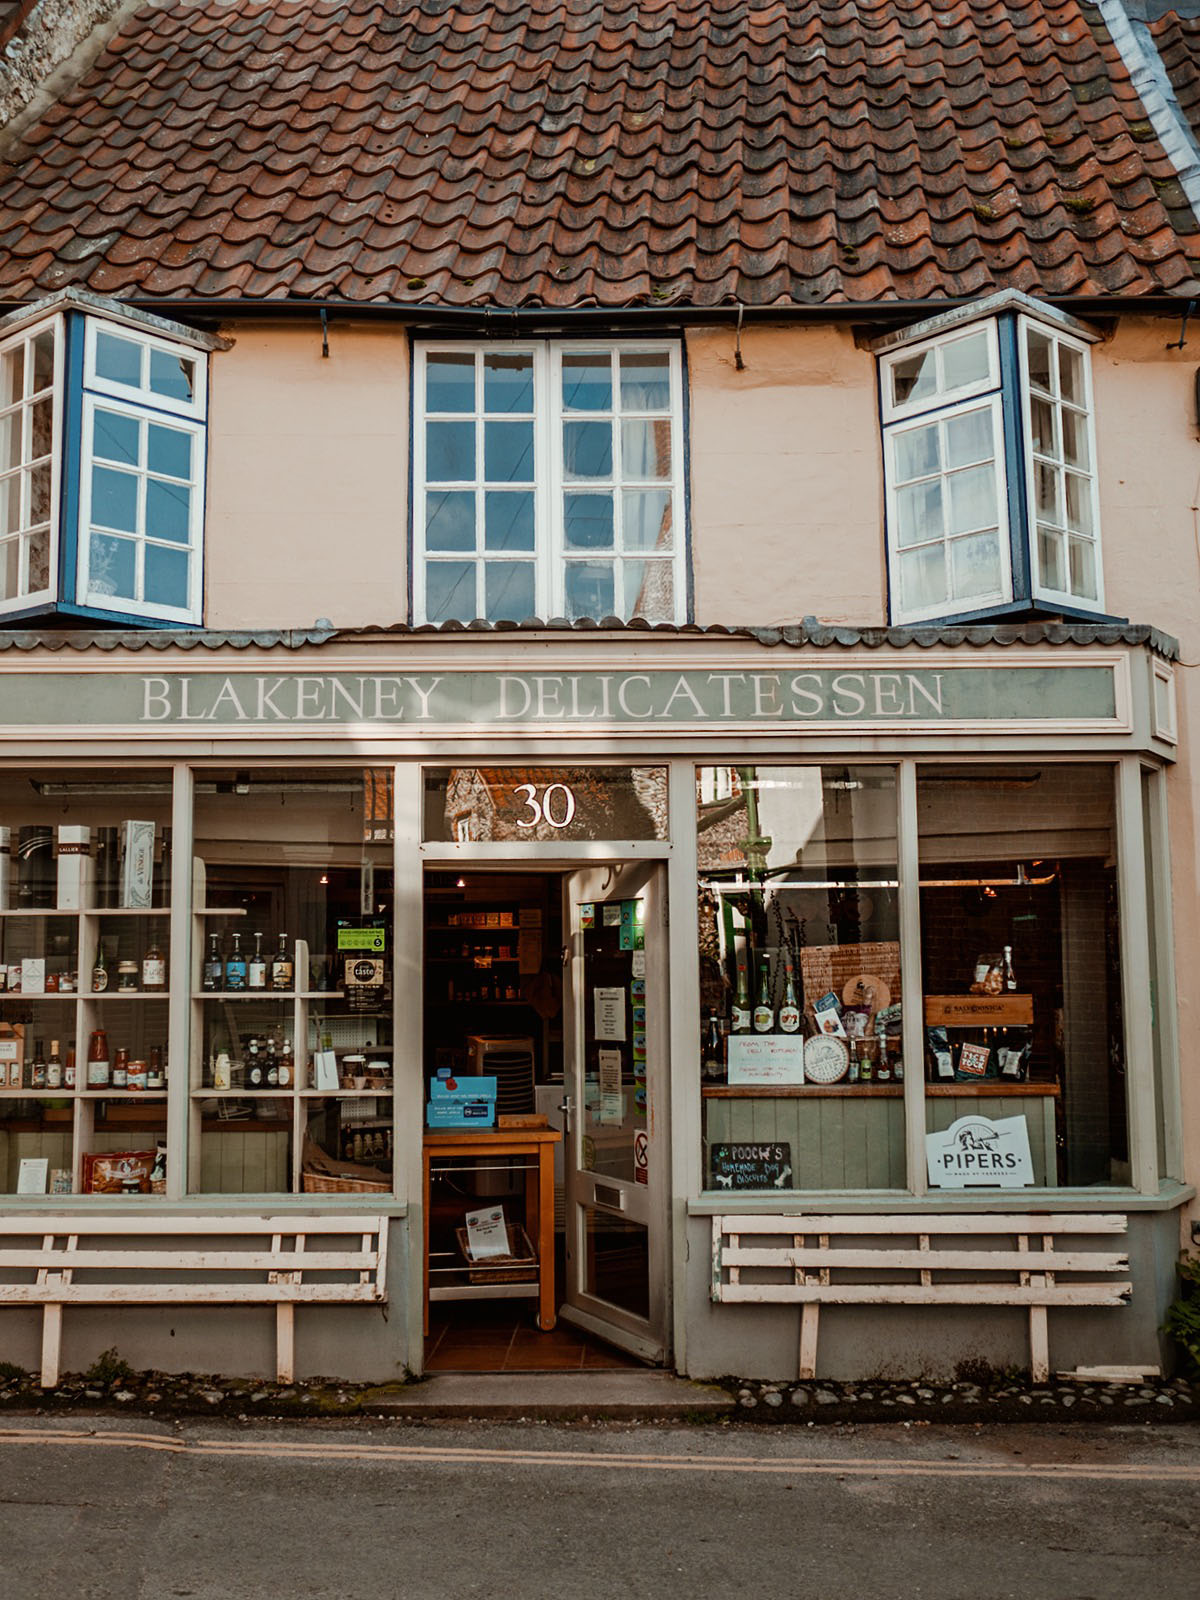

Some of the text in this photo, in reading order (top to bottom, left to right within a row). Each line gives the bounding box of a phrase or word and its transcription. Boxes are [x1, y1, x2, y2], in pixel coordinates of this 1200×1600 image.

[139, 673, 946, 721] BLAKENEY DELICATESSEN
[513, 783, 576, 829] 30
[962, 1058, 985, 1069] TOCK
[963, 1051, 986, 1062] TICK
[943, 1153, 1017, 1169] PIPERS
